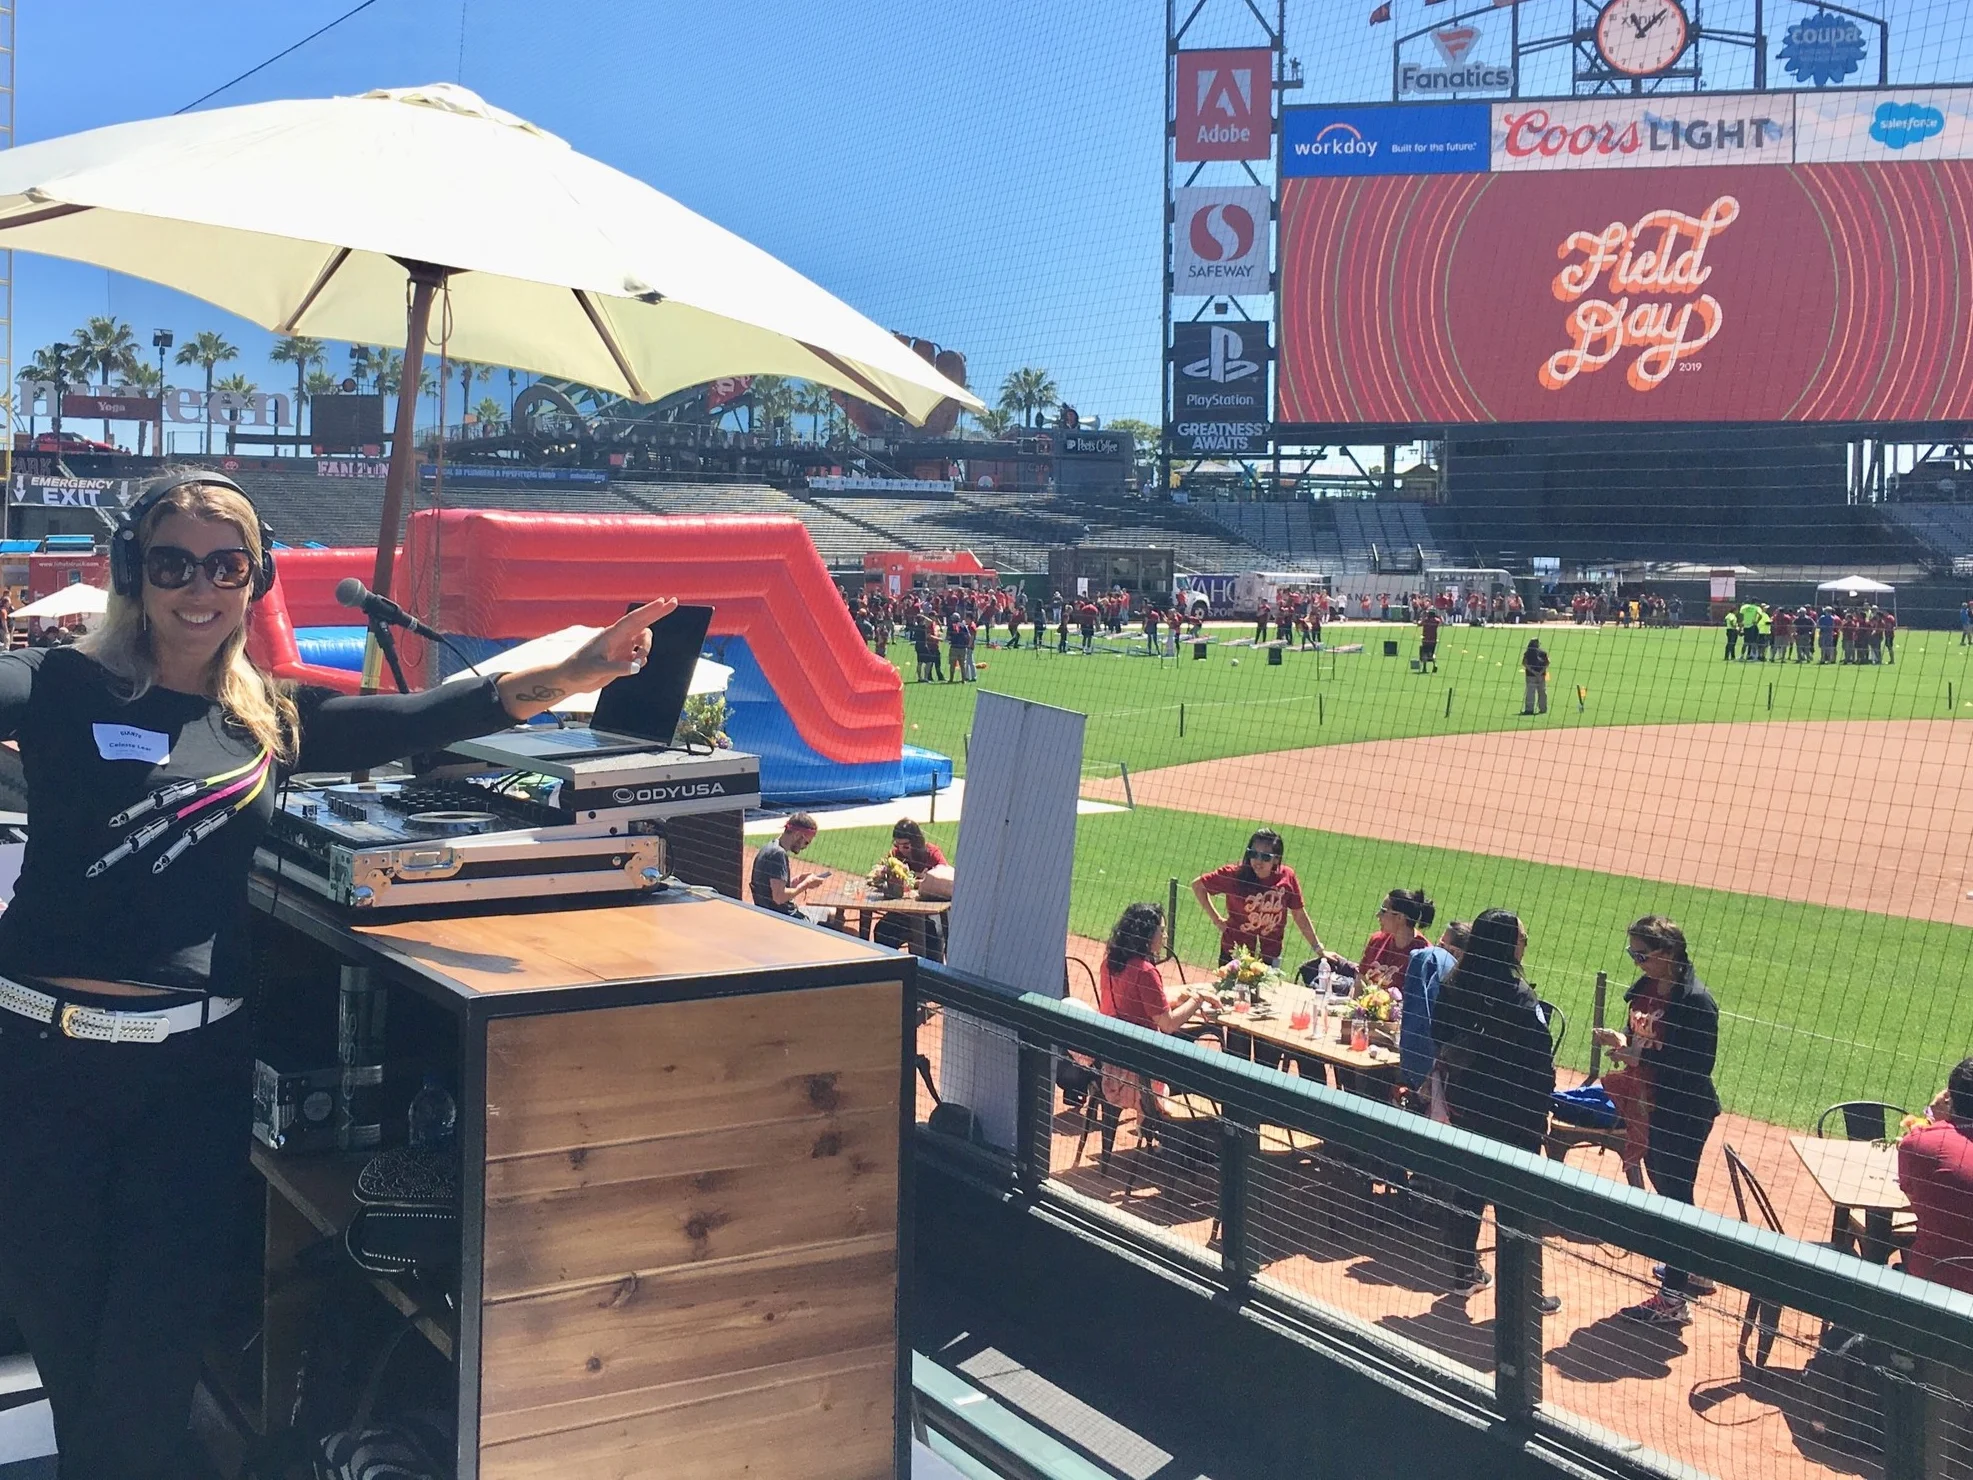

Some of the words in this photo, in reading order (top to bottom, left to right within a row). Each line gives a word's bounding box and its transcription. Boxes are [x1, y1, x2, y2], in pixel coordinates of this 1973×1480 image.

[1791, 27, 1858, 47] coupa
[1403, 66, 1509, 90] Fanatics
[1197, 123, 1250, 143] Adobe
[1504, 109, 1642, 157] Coors
[1650, 118, 1771, 151] LIGHT
[1880, 118, 1938, 130] salesforce
[1295, 139, 1378, 157] workday
[1392, 144, 1412, 153] Built
[1414, 143, 1428, 153] for
[1430, 143, 1444, 152] the
[1554, 195, 1740, 300] Field
[1188, 265, 1254, 278] SAFEWAY
[1541, 294, 1723, 388] Day
[1679, 362, 1702, 372] 2019
[97, 401, 126, 413] Yoga
[1186, 393, 1254, 409] PlayStation
[1178, 423, 1263, 437] GREATNESS
[1096, 439, 1118, 454] Coffee
[1192, 436, 1249, 450] AWAITS
[31, 476, 114, 489] EMERGENCY
[42, 487, 101, 506] EXIT
[636, 782, 725, 802] ODYUSA
[1244, 886, 1286, 913] Field
[1240, 911, 1283, 936] Day
